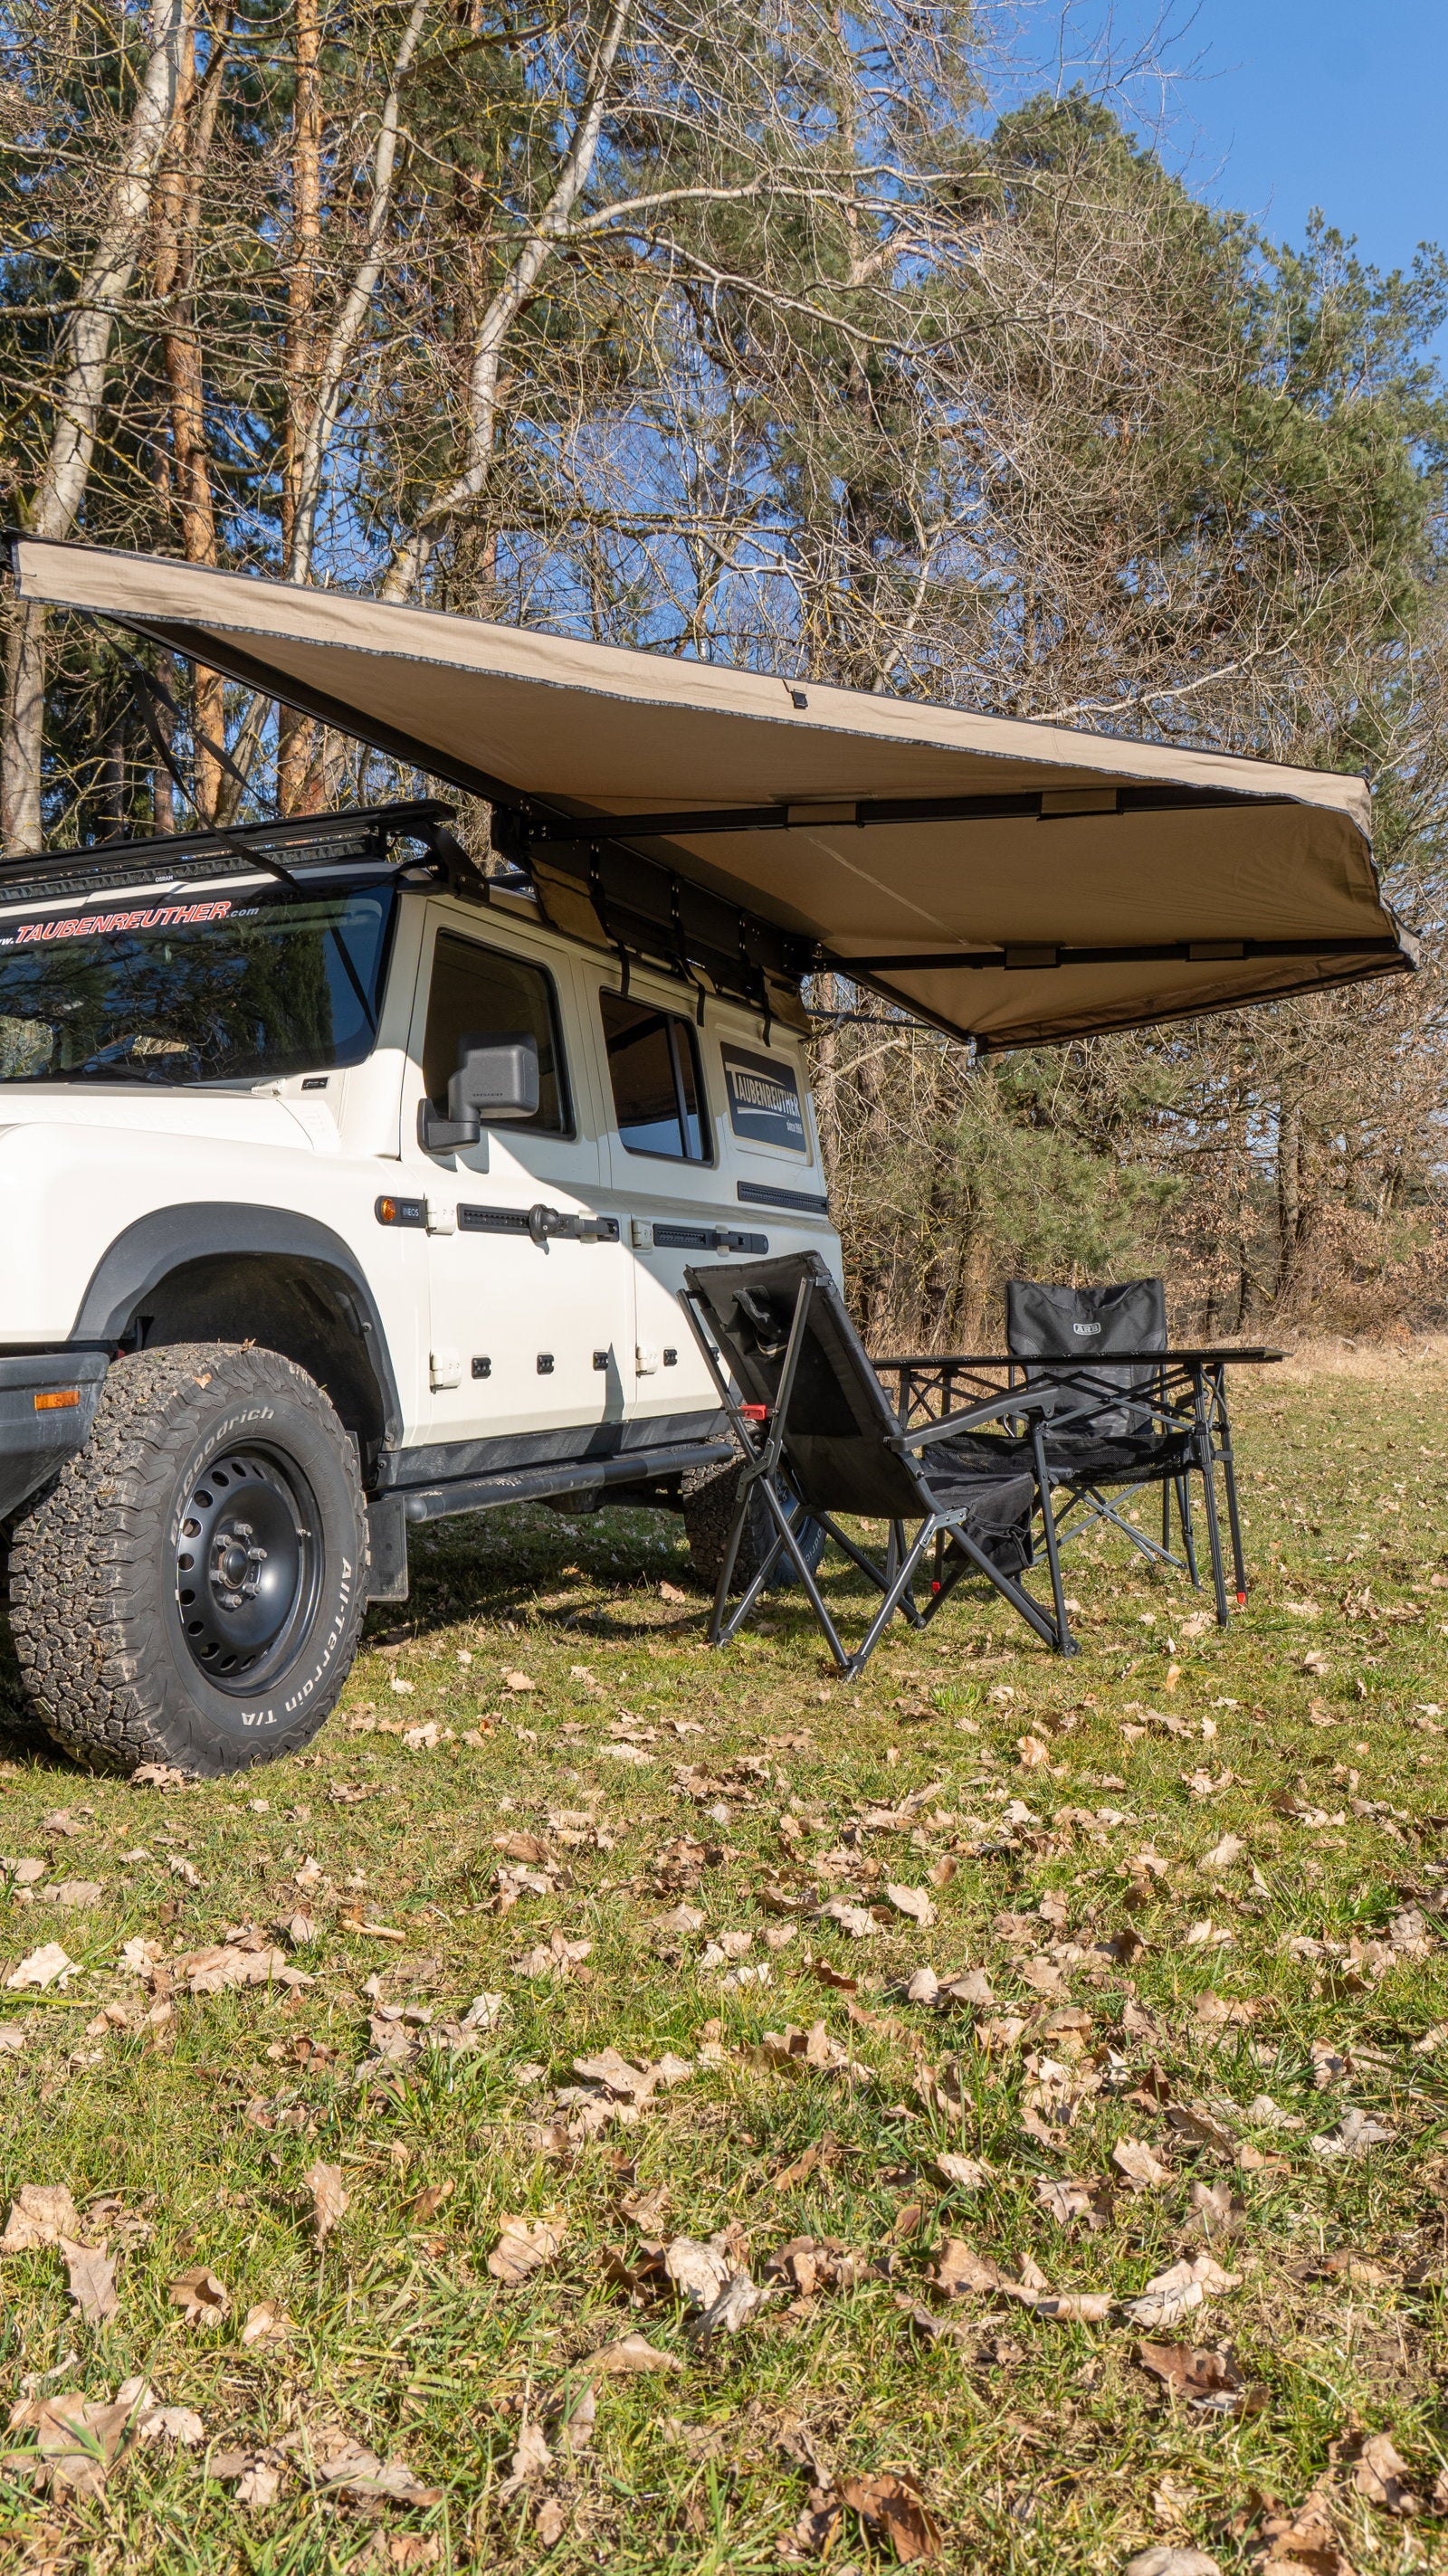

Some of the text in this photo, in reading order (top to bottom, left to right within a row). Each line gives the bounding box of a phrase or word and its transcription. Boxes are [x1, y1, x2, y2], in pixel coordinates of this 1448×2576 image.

[155, 874, 174, 883] OSRAM
[0, 900, 260, 946] w.TAUBENREUTHER.com
[725, 1061, 802, 1118] TAUBENREUTHER
[403, 1207, 419, 1217] INEOS
[1075, 1324, 1100, 1334] ARB
[169, 1405, 275, 1547] BFGoodrich
[285, 1556, 352, 1713] All-Terrain
[241, 1708, 278, 1726] T/A
